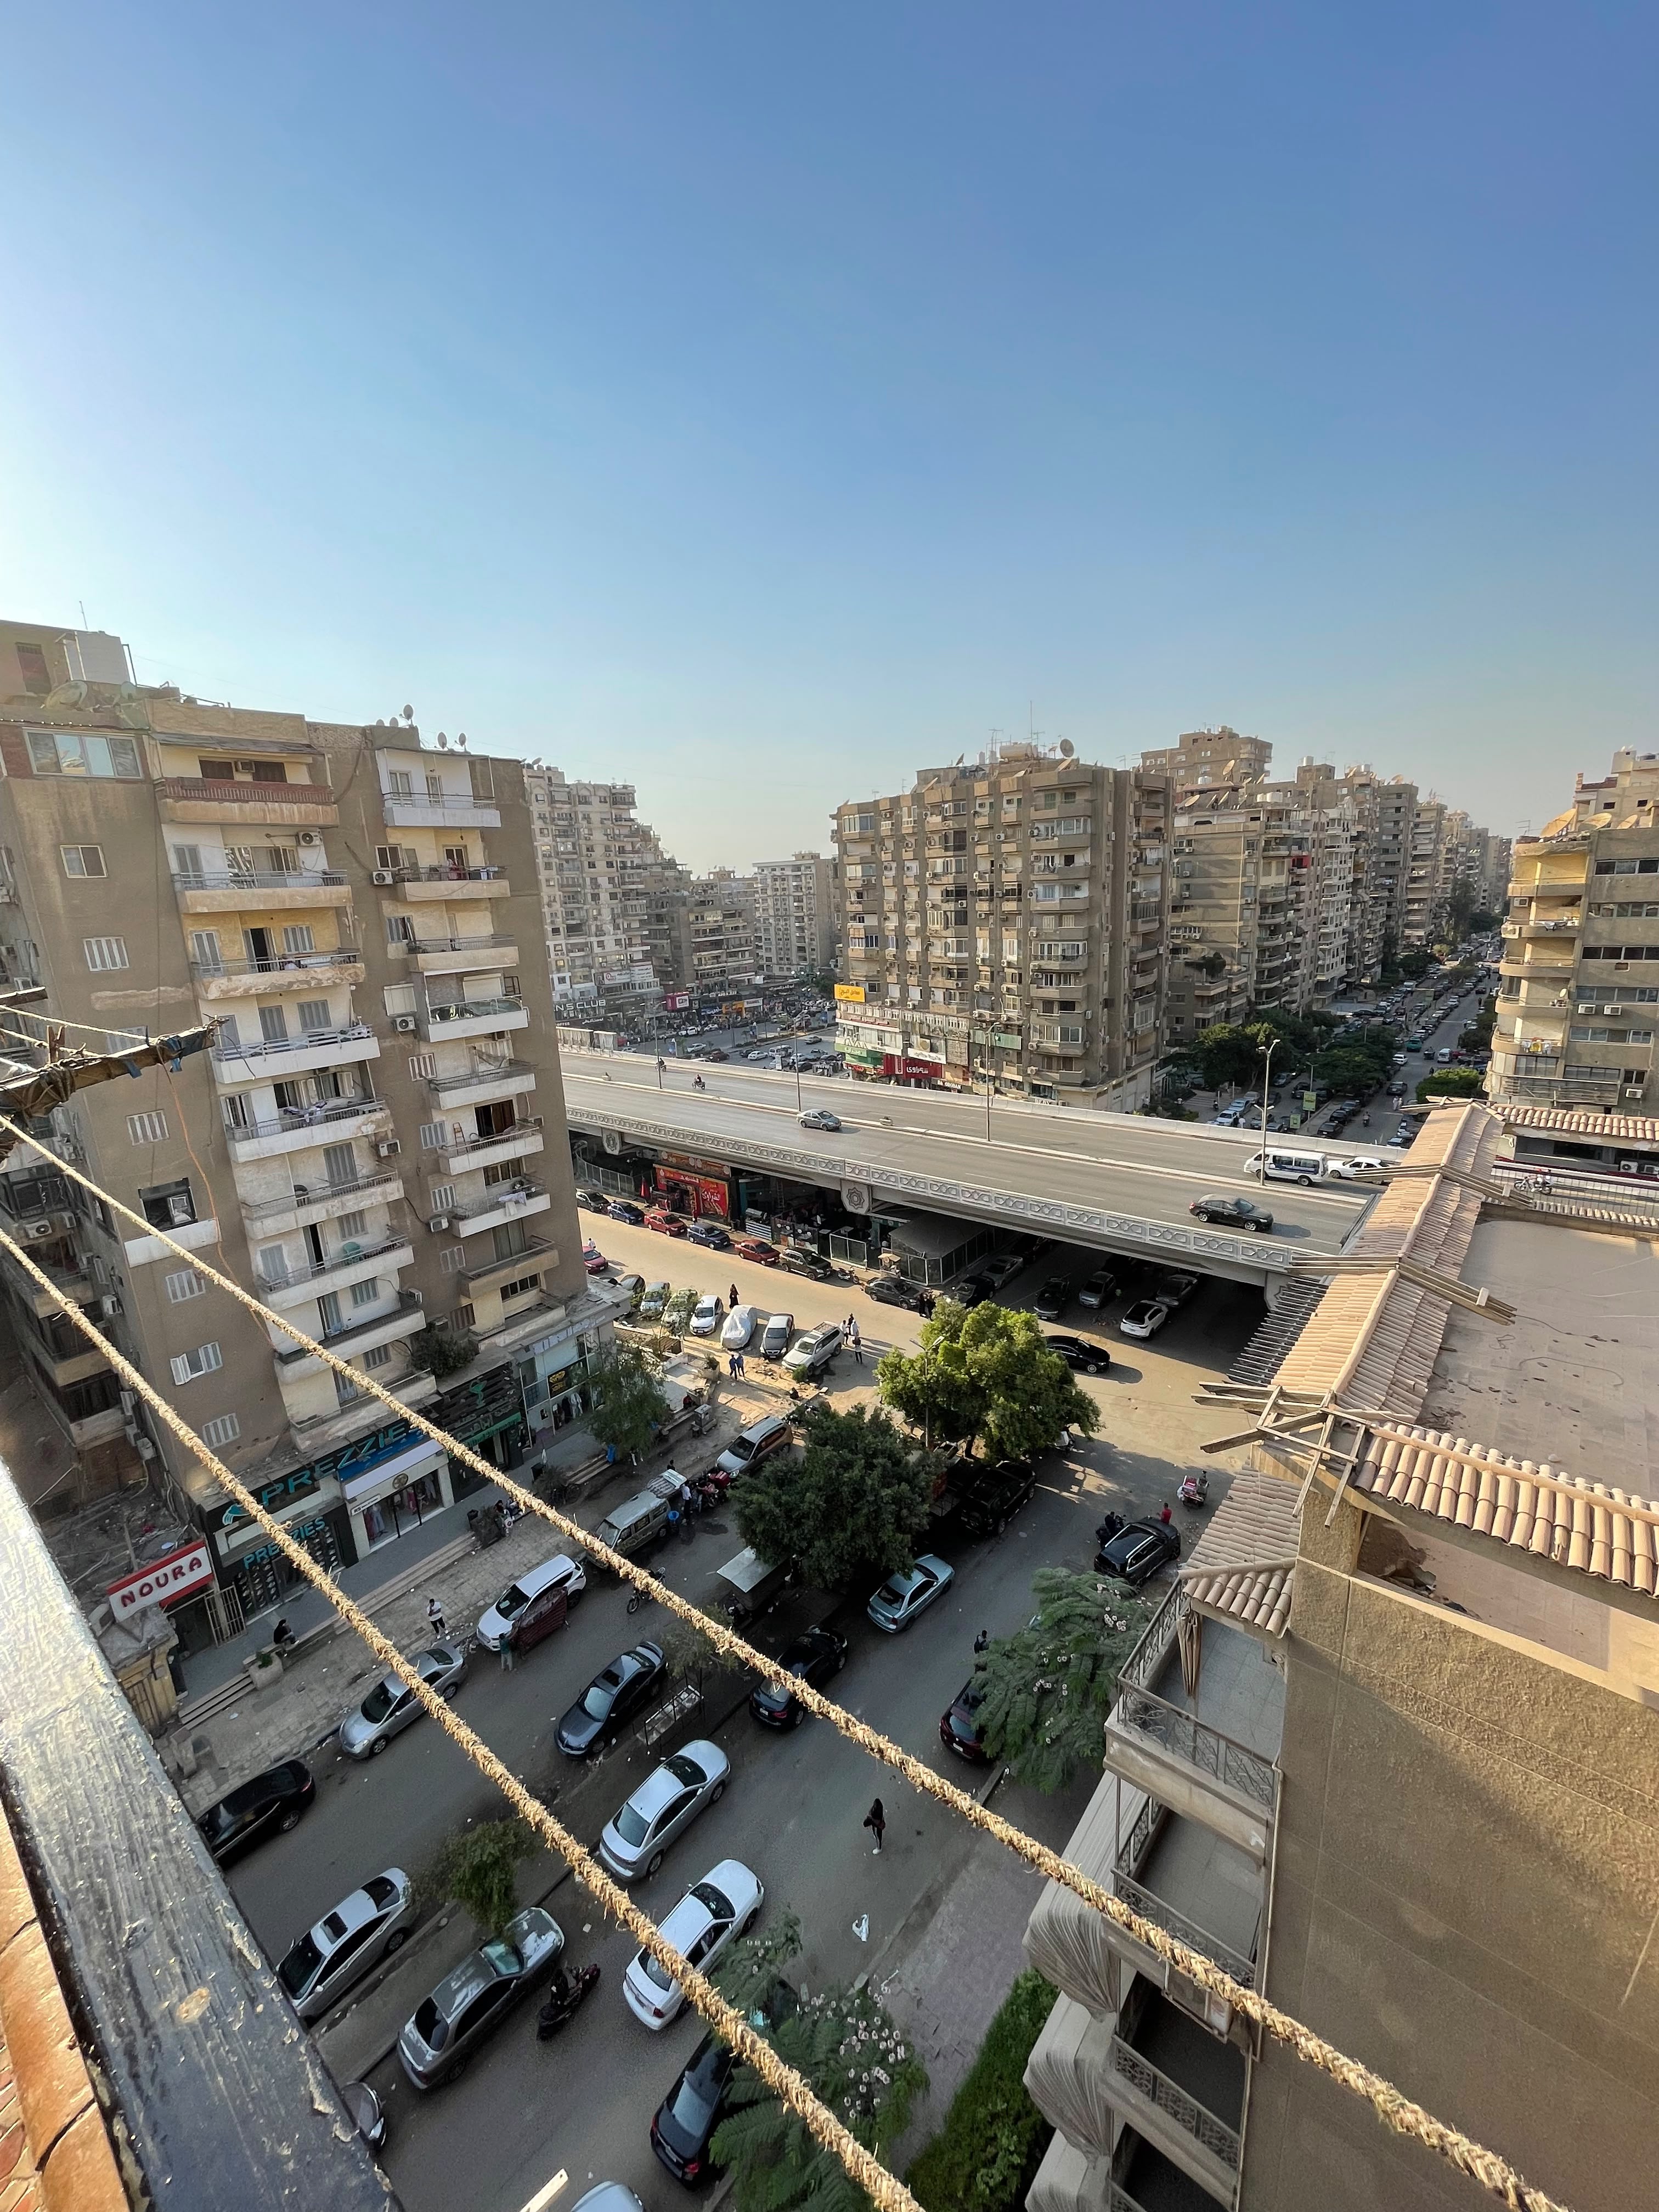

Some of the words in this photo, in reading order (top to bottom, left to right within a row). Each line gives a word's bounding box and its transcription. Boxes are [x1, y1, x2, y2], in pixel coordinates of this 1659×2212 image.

[576, 999, 606, 1009] CLUB
[262, 1422, 419, 1508] PREZZIE
[244, 1517, 326, 1569] PREZIES
[120, 1556, 203, 1608] NOURA
